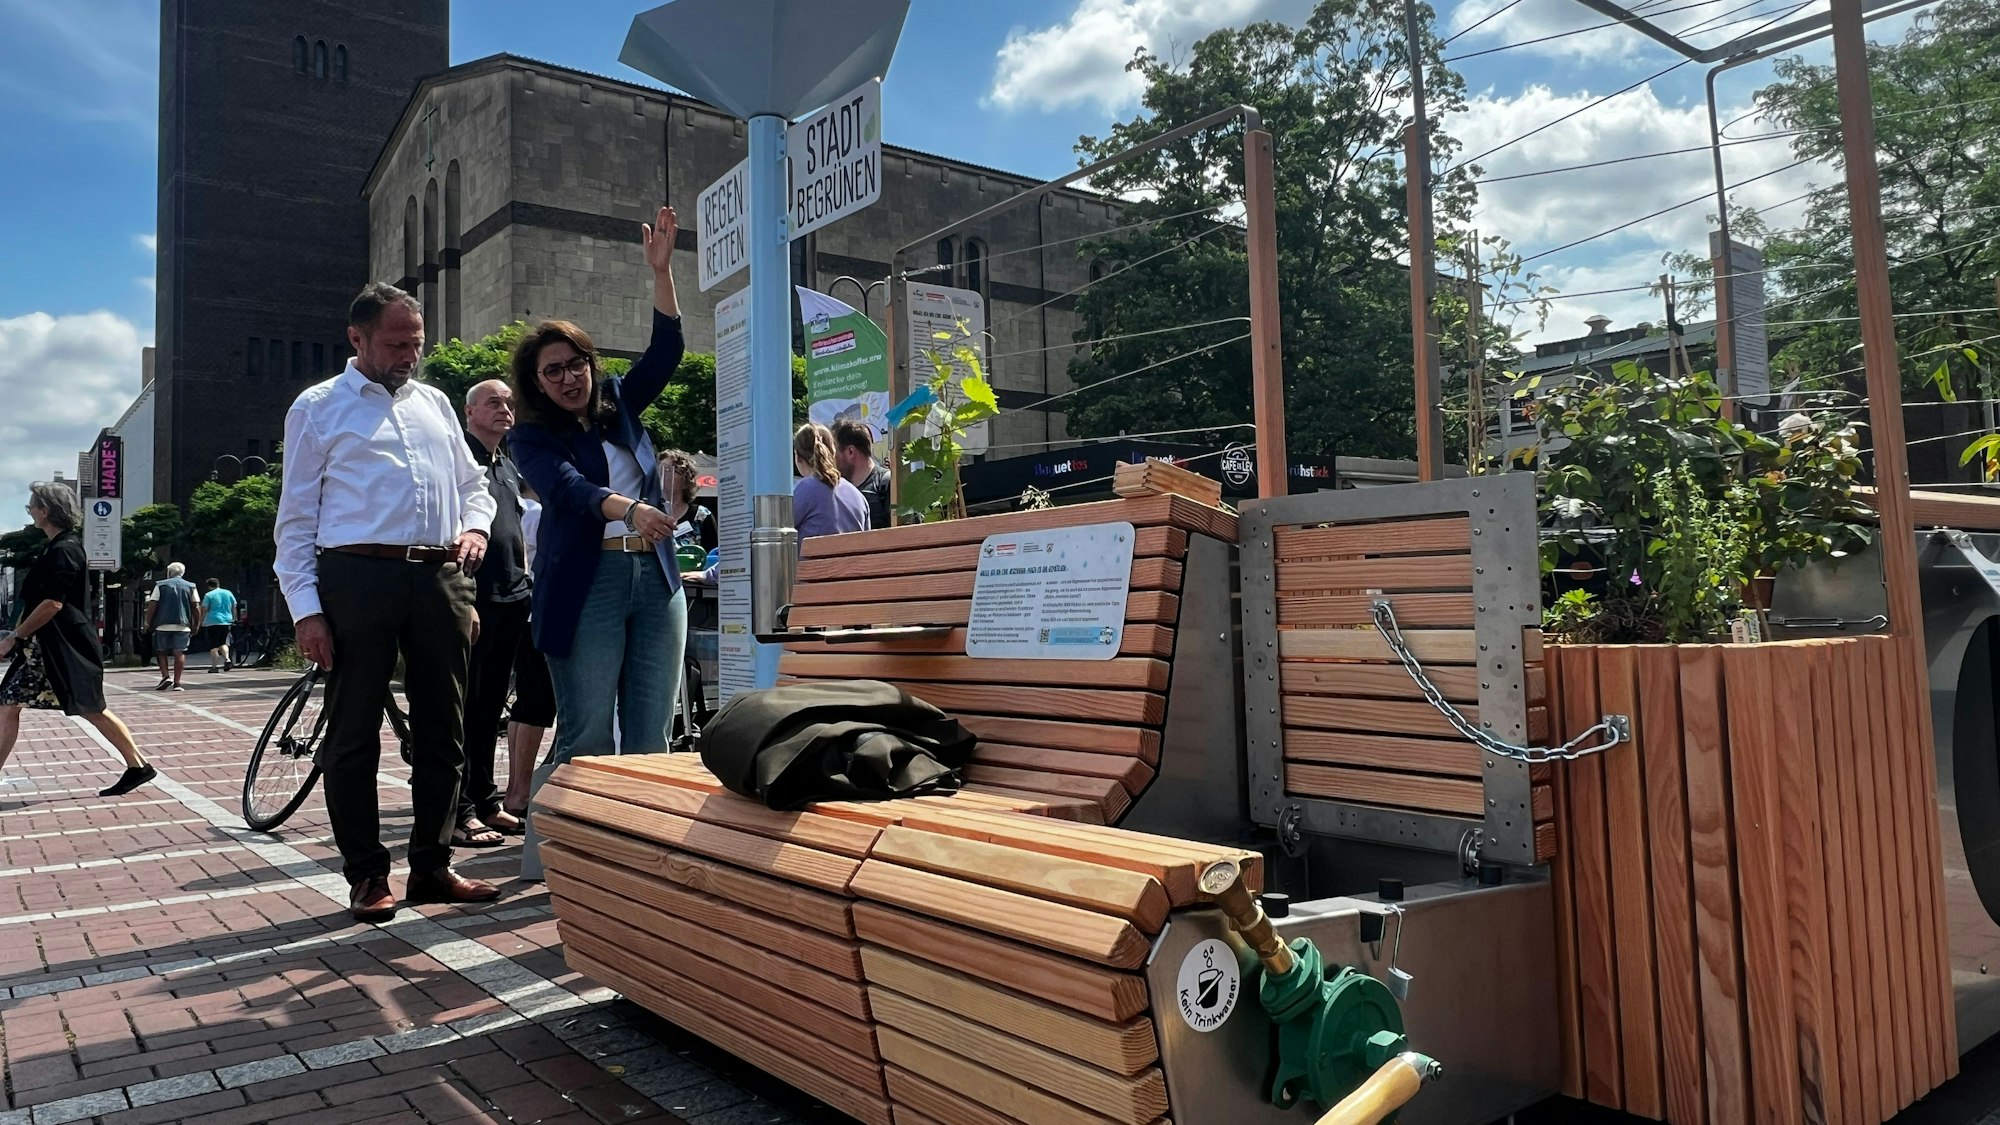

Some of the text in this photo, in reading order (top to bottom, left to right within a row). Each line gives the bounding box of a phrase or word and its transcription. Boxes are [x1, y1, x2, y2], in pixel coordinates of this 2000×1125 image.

[806, 95, 864, 175] STADT
[704, 170, 743, 239] REGEN
[797, 150, 876, 229] BEGRÜNEN
[706, 223, 744, 280] RETTEN
[1180, 977, 1237, 1028] Kein Trinkwasser
